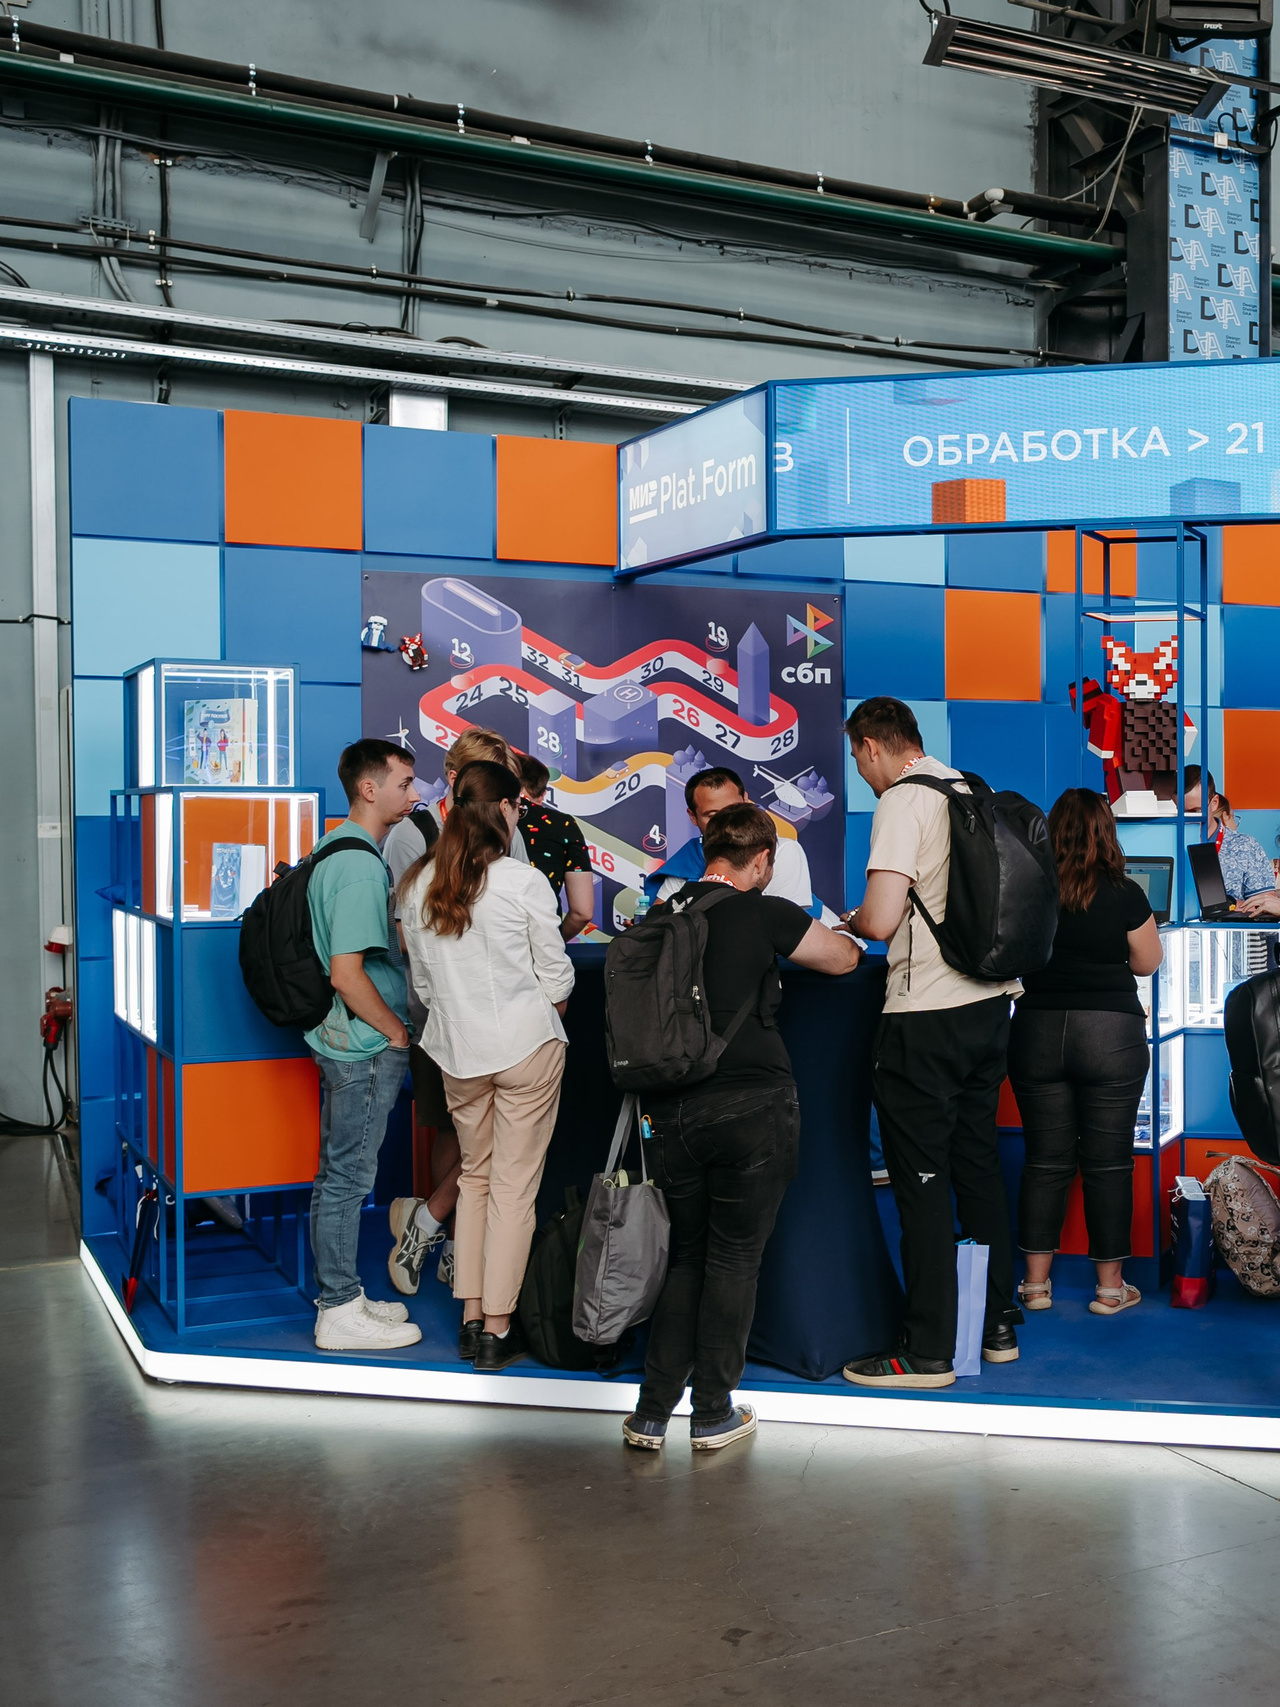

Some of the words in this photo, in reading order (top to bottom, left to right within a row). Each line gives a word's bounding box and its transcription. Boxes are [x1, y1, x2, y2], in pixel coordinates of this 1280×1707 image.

[903, 426, 1171, 467] ОБРАБОТКА
[1225, 421, 1264, 455] 21
[629, 479, 658, 512] МИР
[660, 453, 757, 515] Plat.Form
[707, 621, 728, 648] 19
[451, 638, 471, 663] 12
[526, 645, 549, 671] 32
[561, 668, 583, 691] 31
[641, 656, 664, 680] 30
[702, 669, 724, 693] 29
[780, 662, 831, 684] сбп
[455, 684, 483, 714] 24
[499, 676, 530, 709] 25
[672, 699, 701, 728] 26
[537, 726, 560, 753] 28
[715, 723, 741, 750] 27
[769, 729, 795, 756] 28
[546, 786, 558, 808] 1
[614, 772, 641, 801] 20
[649, 824, 661, 844] 4
[588, 845, 615, 872] 16
